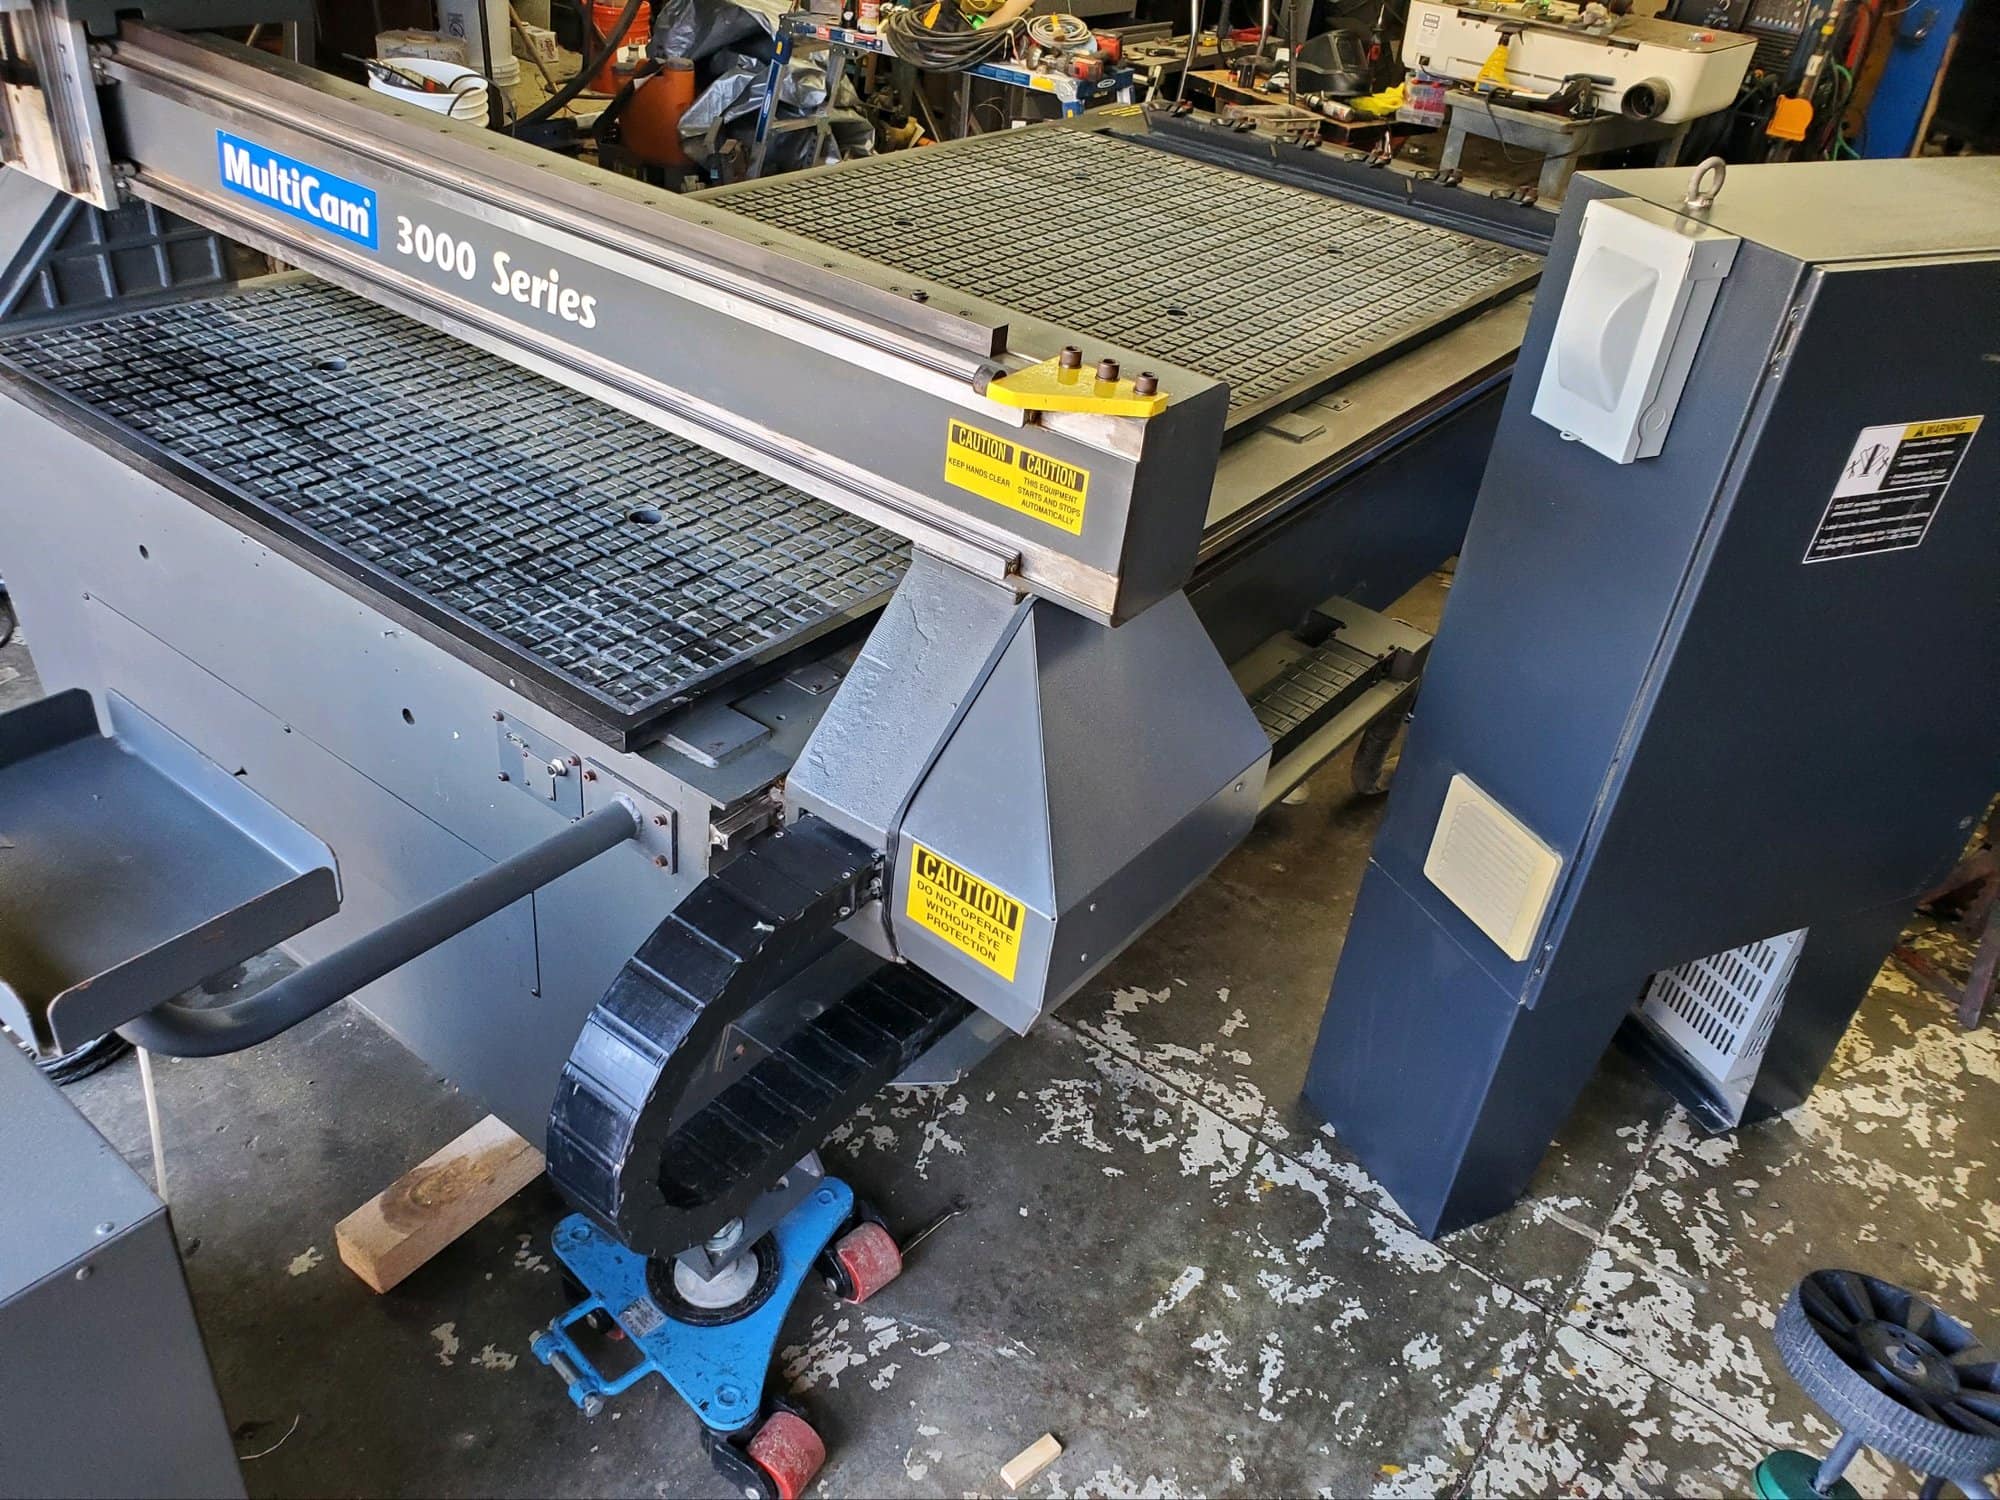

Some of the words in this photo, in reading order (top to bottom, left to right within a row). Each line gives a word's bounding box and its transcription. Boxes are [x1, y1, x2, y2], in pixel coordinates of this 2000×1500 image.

[223, 142, 370, 239] MultiCam
[396, 215, 477, 281] 3000
[491, 251, 598, 330] Series
[958, 428, 1007, 463] CAUTION
[948, 457, 966, 469] KEEP
[966, 464, 989, 480] HANDS
[988, 473, 1011, 488] CLEAR
[1024, 477, 1039, 489] THIS
[1039, 485, 1078, 505] EQUIPMENT
[1026, 454, 1078, 490] CAUTION
[1017, 486, 1043, 502] STARTS
[1043, 496, 1058, 509] AND
[1059, 503, 1081, 518] STOPS
[1021, 499, 1075, 526] AUTOMATICALLY
[923, 855, 1012, 927] CAUTION
[917, 880, 933, 896] DO
[935, 891, 959, 910] NOT
[960, 907, 1014, 946] OPERATE
[926, 898, 976, 935] WITHOUT
[978, 930, 1001, 952] EYE
[926, 912, 997, 962] PROTECTION
